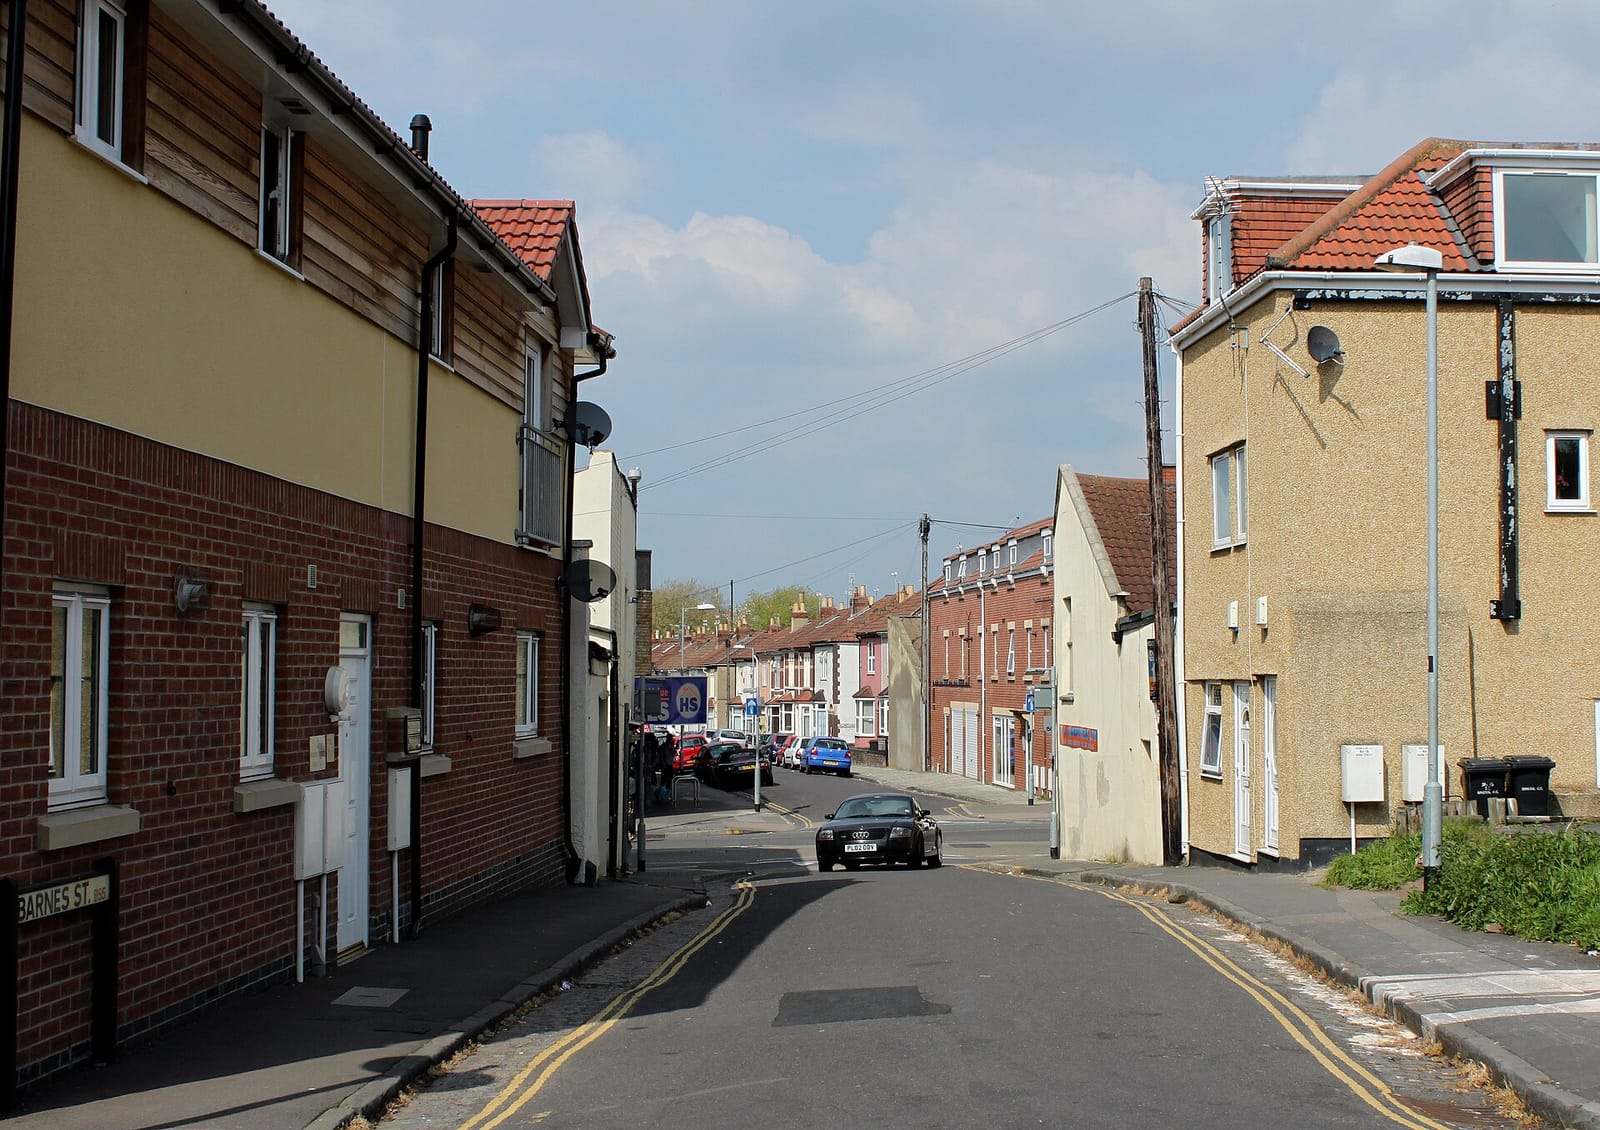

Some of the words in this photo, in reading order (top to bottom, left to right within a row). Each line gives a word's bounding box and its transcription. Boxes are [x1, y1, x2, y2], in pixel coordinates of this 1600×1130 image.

[680, 697, 698, 713] HS
[18, 886, 70, 921] BARNES
[74, 881, 91, 907] ST.
